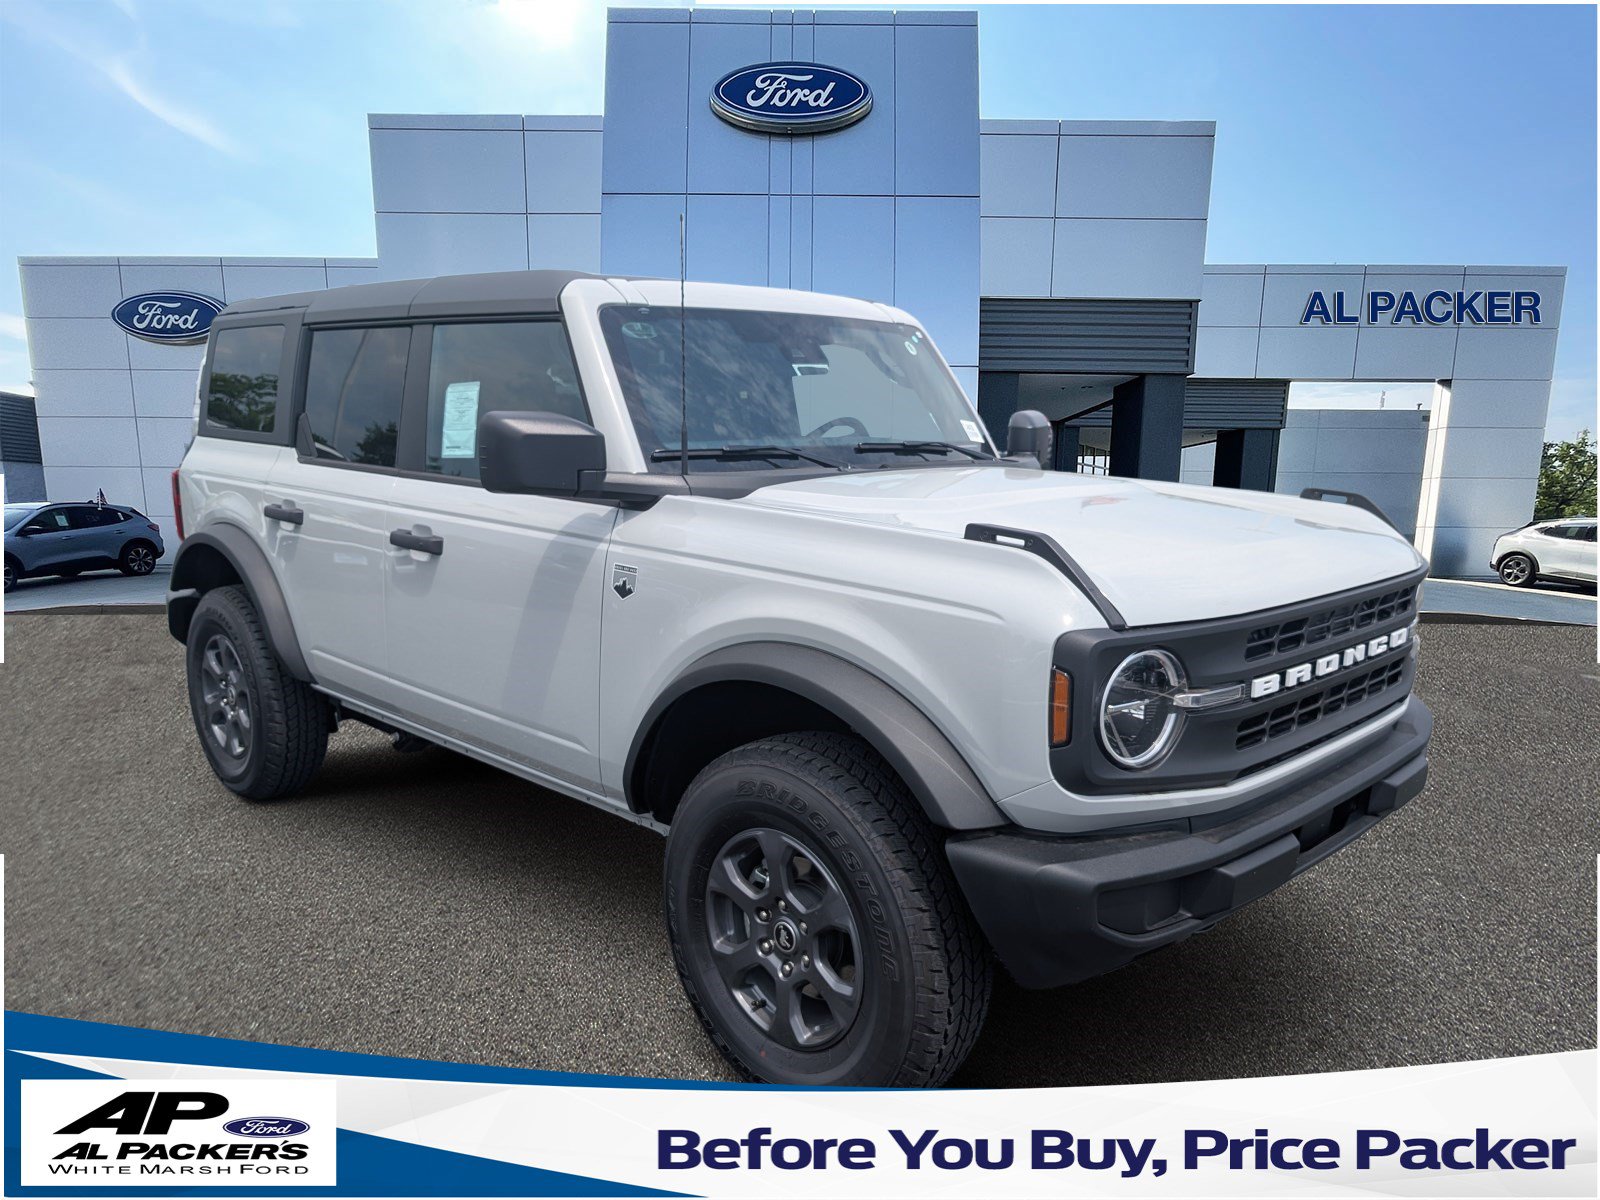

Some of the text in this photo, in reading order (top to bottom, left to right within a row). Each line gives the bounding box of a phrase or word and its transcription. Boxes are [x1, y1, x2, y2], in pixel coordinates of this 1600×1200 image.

[746, 73, 836, 107] Ford
[133, 301, 199, 329] Ford
[1301, 290, 1543, 325] AL PACKER
[1251, 627, 1409, 699] BRONCO
[735, 780, 899, 982] BRIDGESTONE
